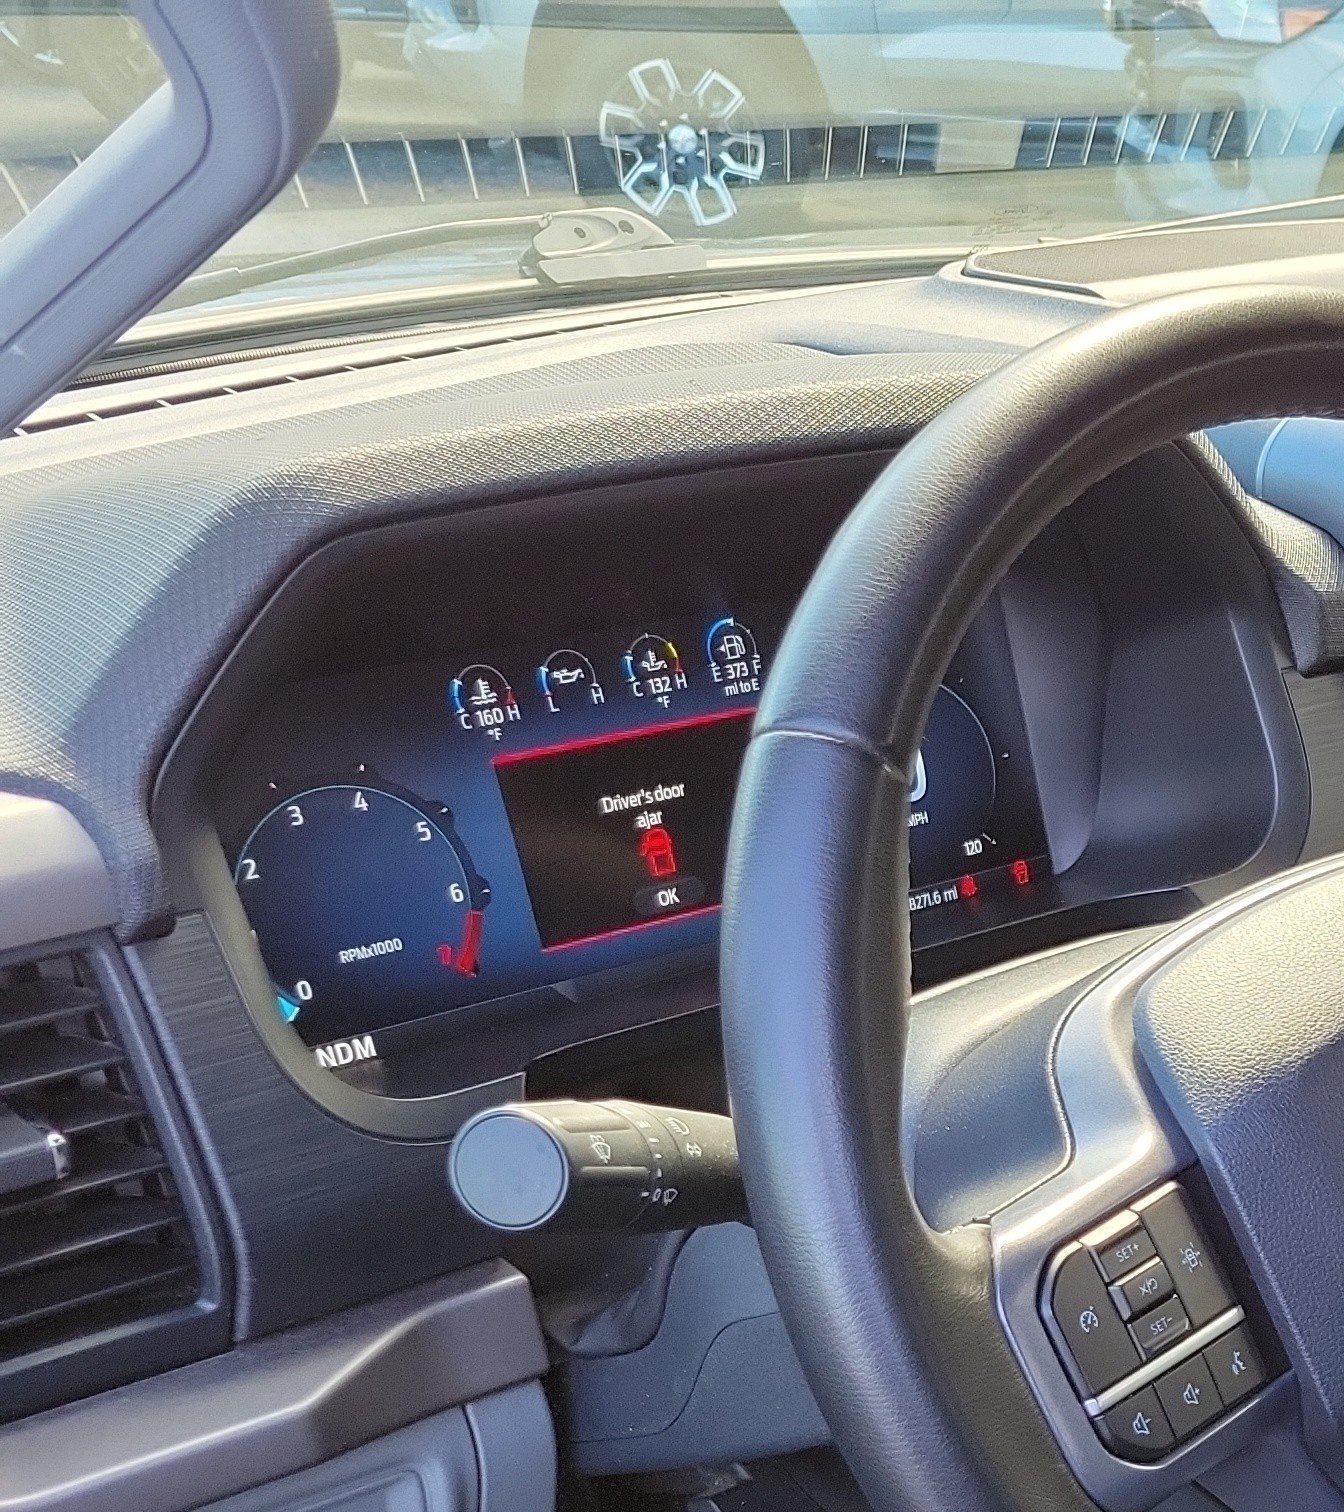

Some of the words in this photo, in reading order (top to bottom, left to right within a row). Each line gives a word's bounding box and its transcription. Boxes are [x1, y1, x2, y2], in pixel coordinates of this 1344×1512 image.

[712, 667, 723, 682] E
[725, 662, 749, 679] 373
[752, 660, 761, 675] F
[633, 682, 644, 697] C
[648, 676, 673, 694] 132
[675, 672, 688, 690] H
[740, 680, 751, 693] to
[751, 678, 761, 691] E
[548, 697, 560, 713] L
[591, 687, 605, 705] H
[460, 713, 473, 730] C
[476, 707, 505, 727] 160
[506, 703, 521, 721] H
[353, 790, 369, 811] 4
[601, 788, 653, 813] Driver's
[654, 783, 685, 802] door
[287, 805, 304, 826] 3
[636, 810, 662, 829] ajar
[416, 821, 432, 842] 5
[963, 838, 983, 856] 120
[242, 858, 260, 880] 2
[449, 882, 464, 903] 6
[658, 887, 681, 906] OK
[338, 937, 403, 964] RPMx1000
[296, 980, 313, 1001] 0
[314, 1034, 378, 1069] NDM
